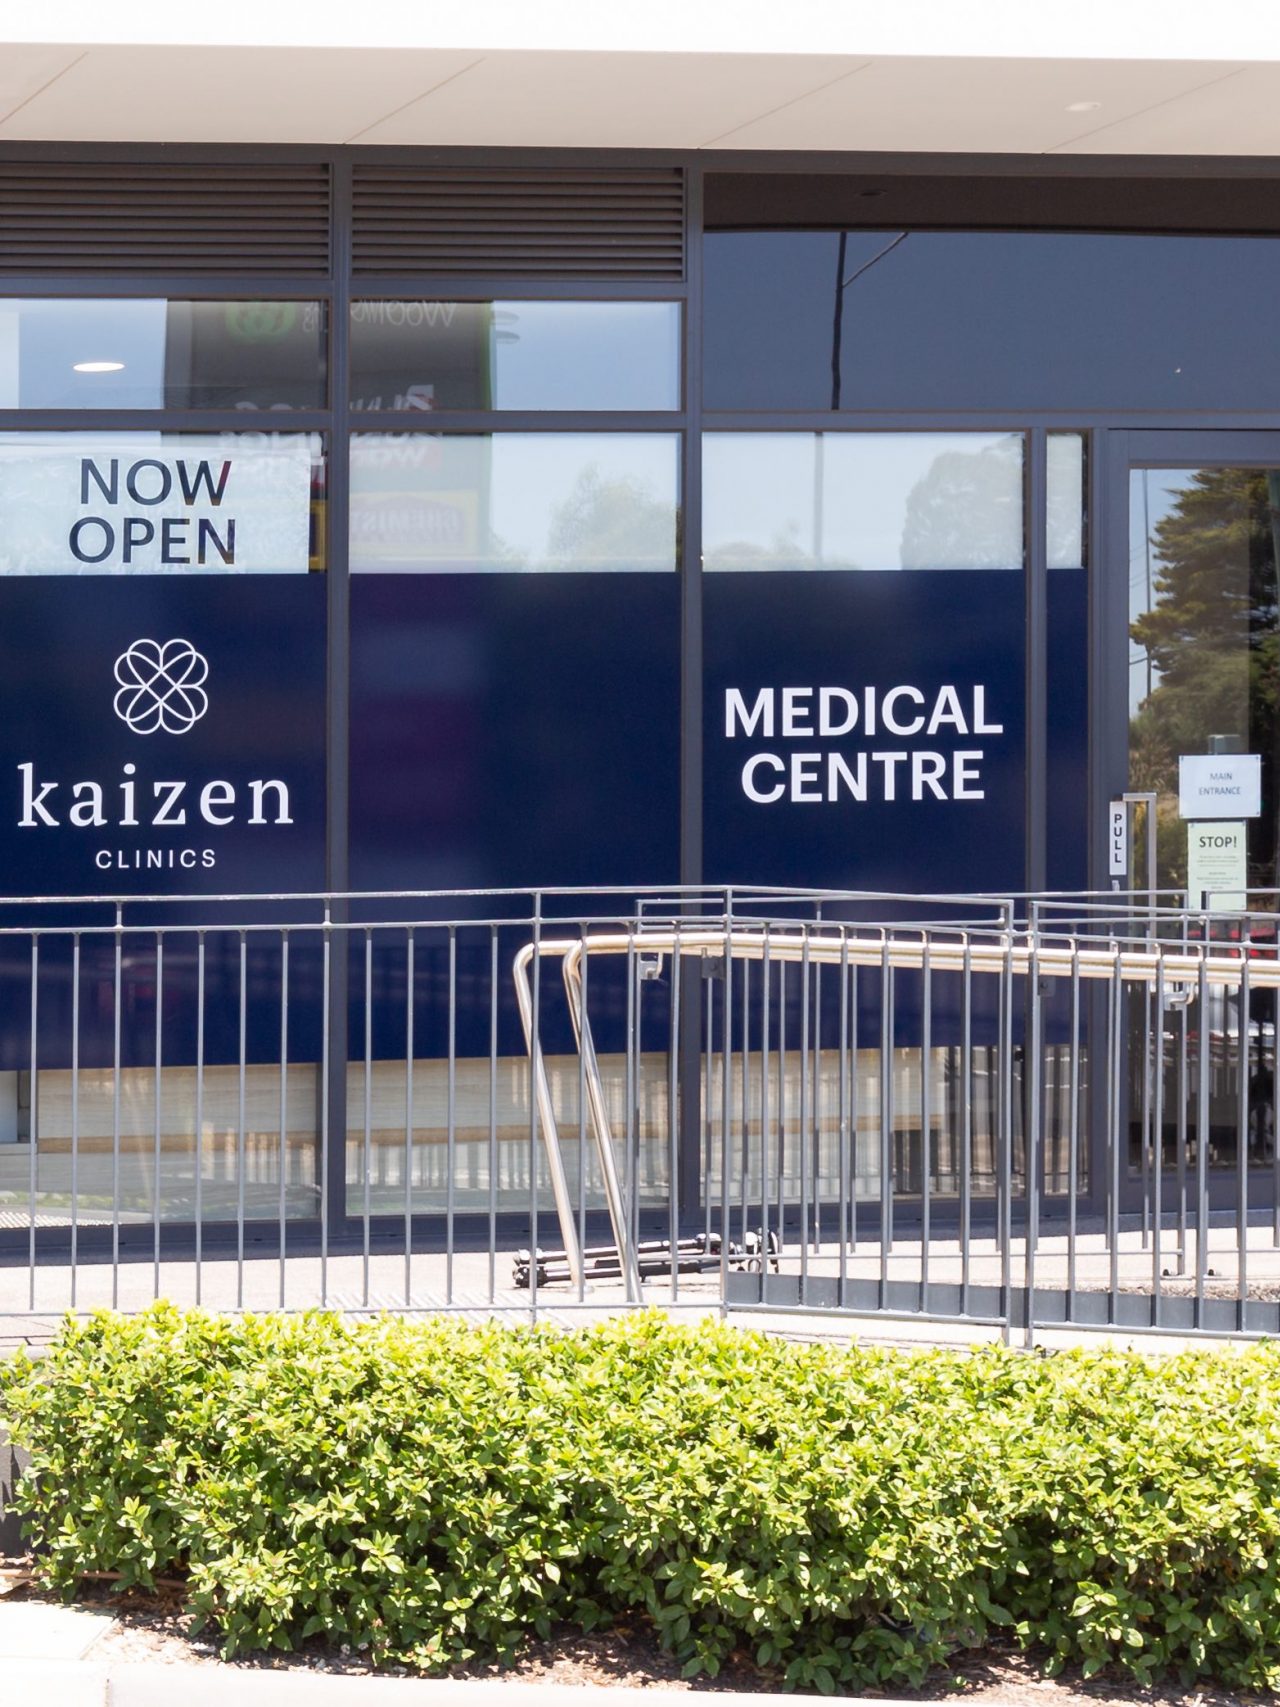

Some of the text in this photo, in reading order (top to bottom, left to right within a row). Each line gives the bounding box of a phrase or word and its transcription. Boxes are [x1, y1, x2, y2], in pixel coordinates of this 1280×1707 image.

[80, 458, 232, 507] NOW
[69, 516, 236, 565] OPEN
[725, 684, 1004, 738] MEDICAL
[17, 762, 294, 827] kaizen
[741, 750, 985, 804] CENTRE
[1199, 786, 1241, 796] ENTRANCE
[1209, 772, 1233, 781] MAIN
[95, 848, 216, 869] CLINICS
[1113, 813, 1123, 864] PULL
[1199, 835, 1237, 848] STOP!
